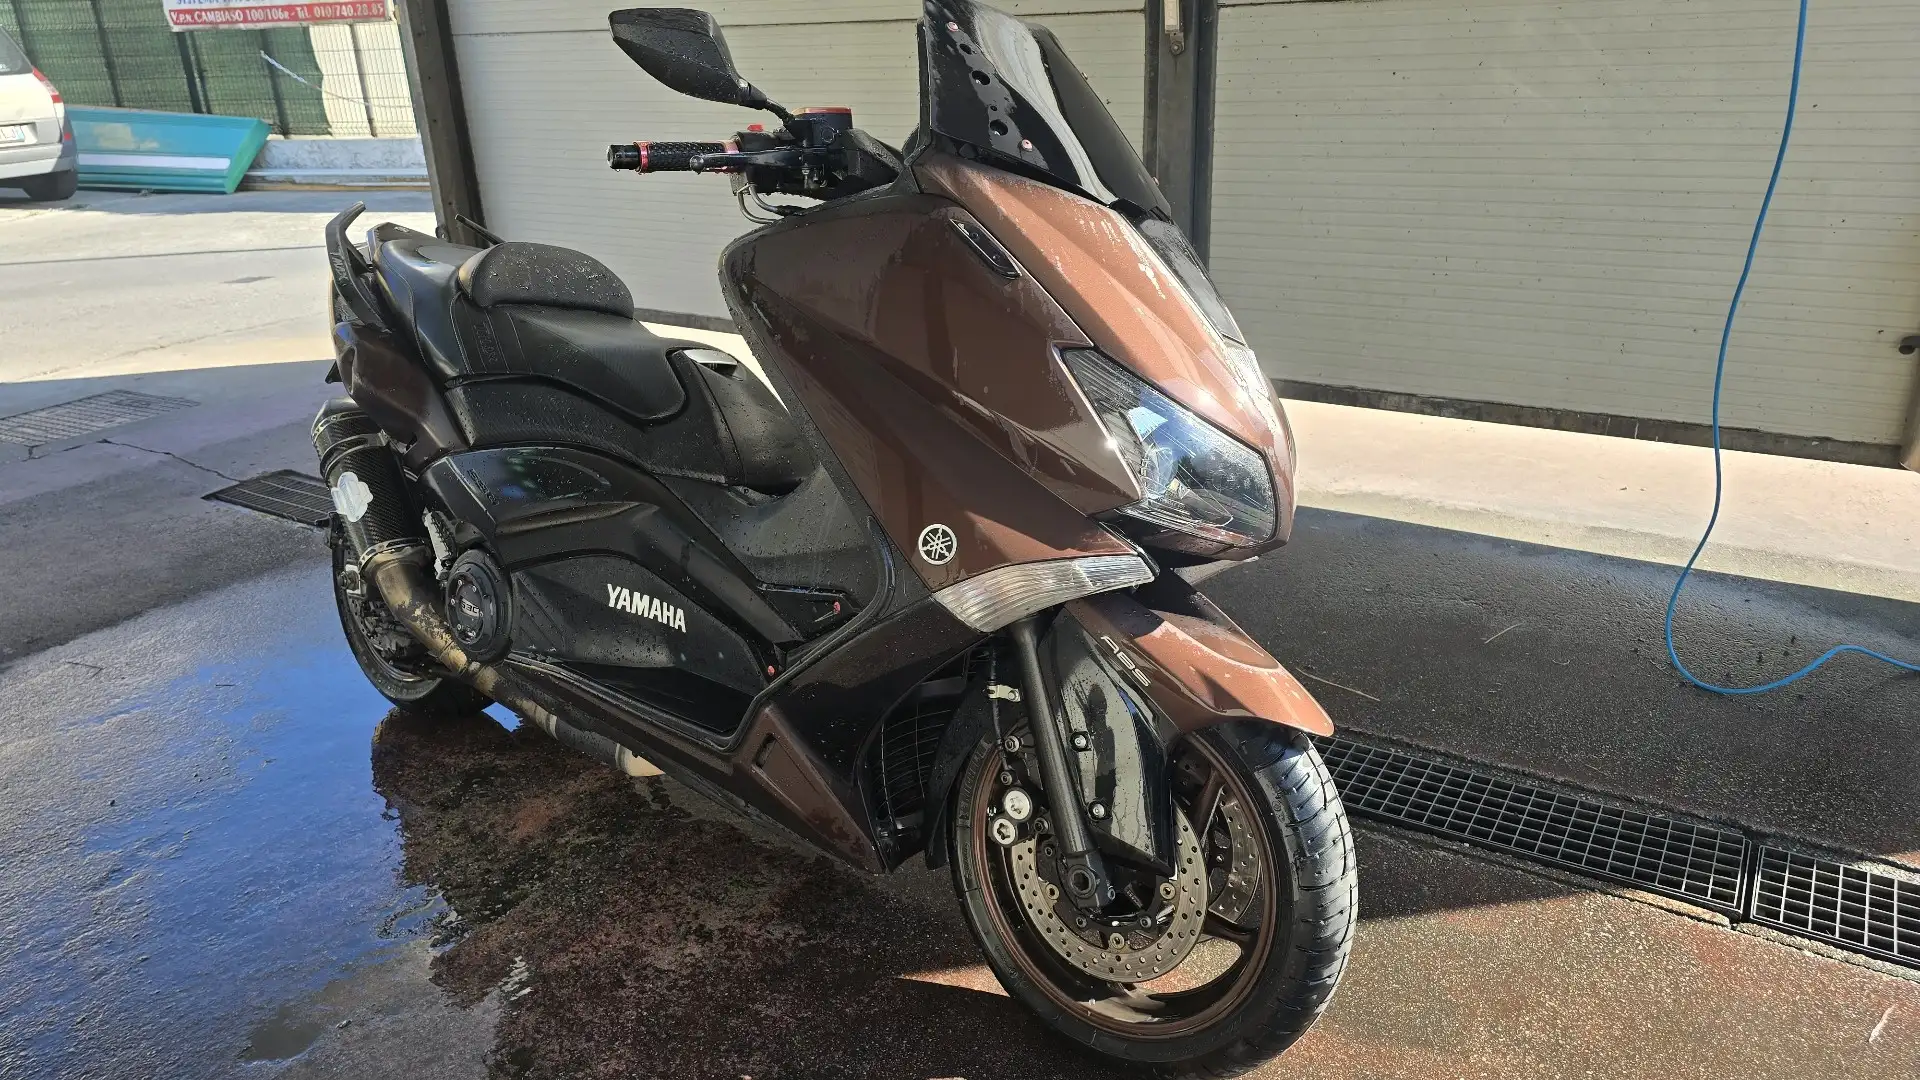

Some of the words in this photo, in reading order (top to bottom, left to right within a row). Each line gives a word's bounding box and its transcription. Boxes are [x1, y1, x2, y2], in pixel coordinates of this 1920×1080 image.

[194, 9, 244, 22] CAMBIASO
[607, 583, 686, 633] YAMAHA
[1100, 635, 1152, 687] ABS
